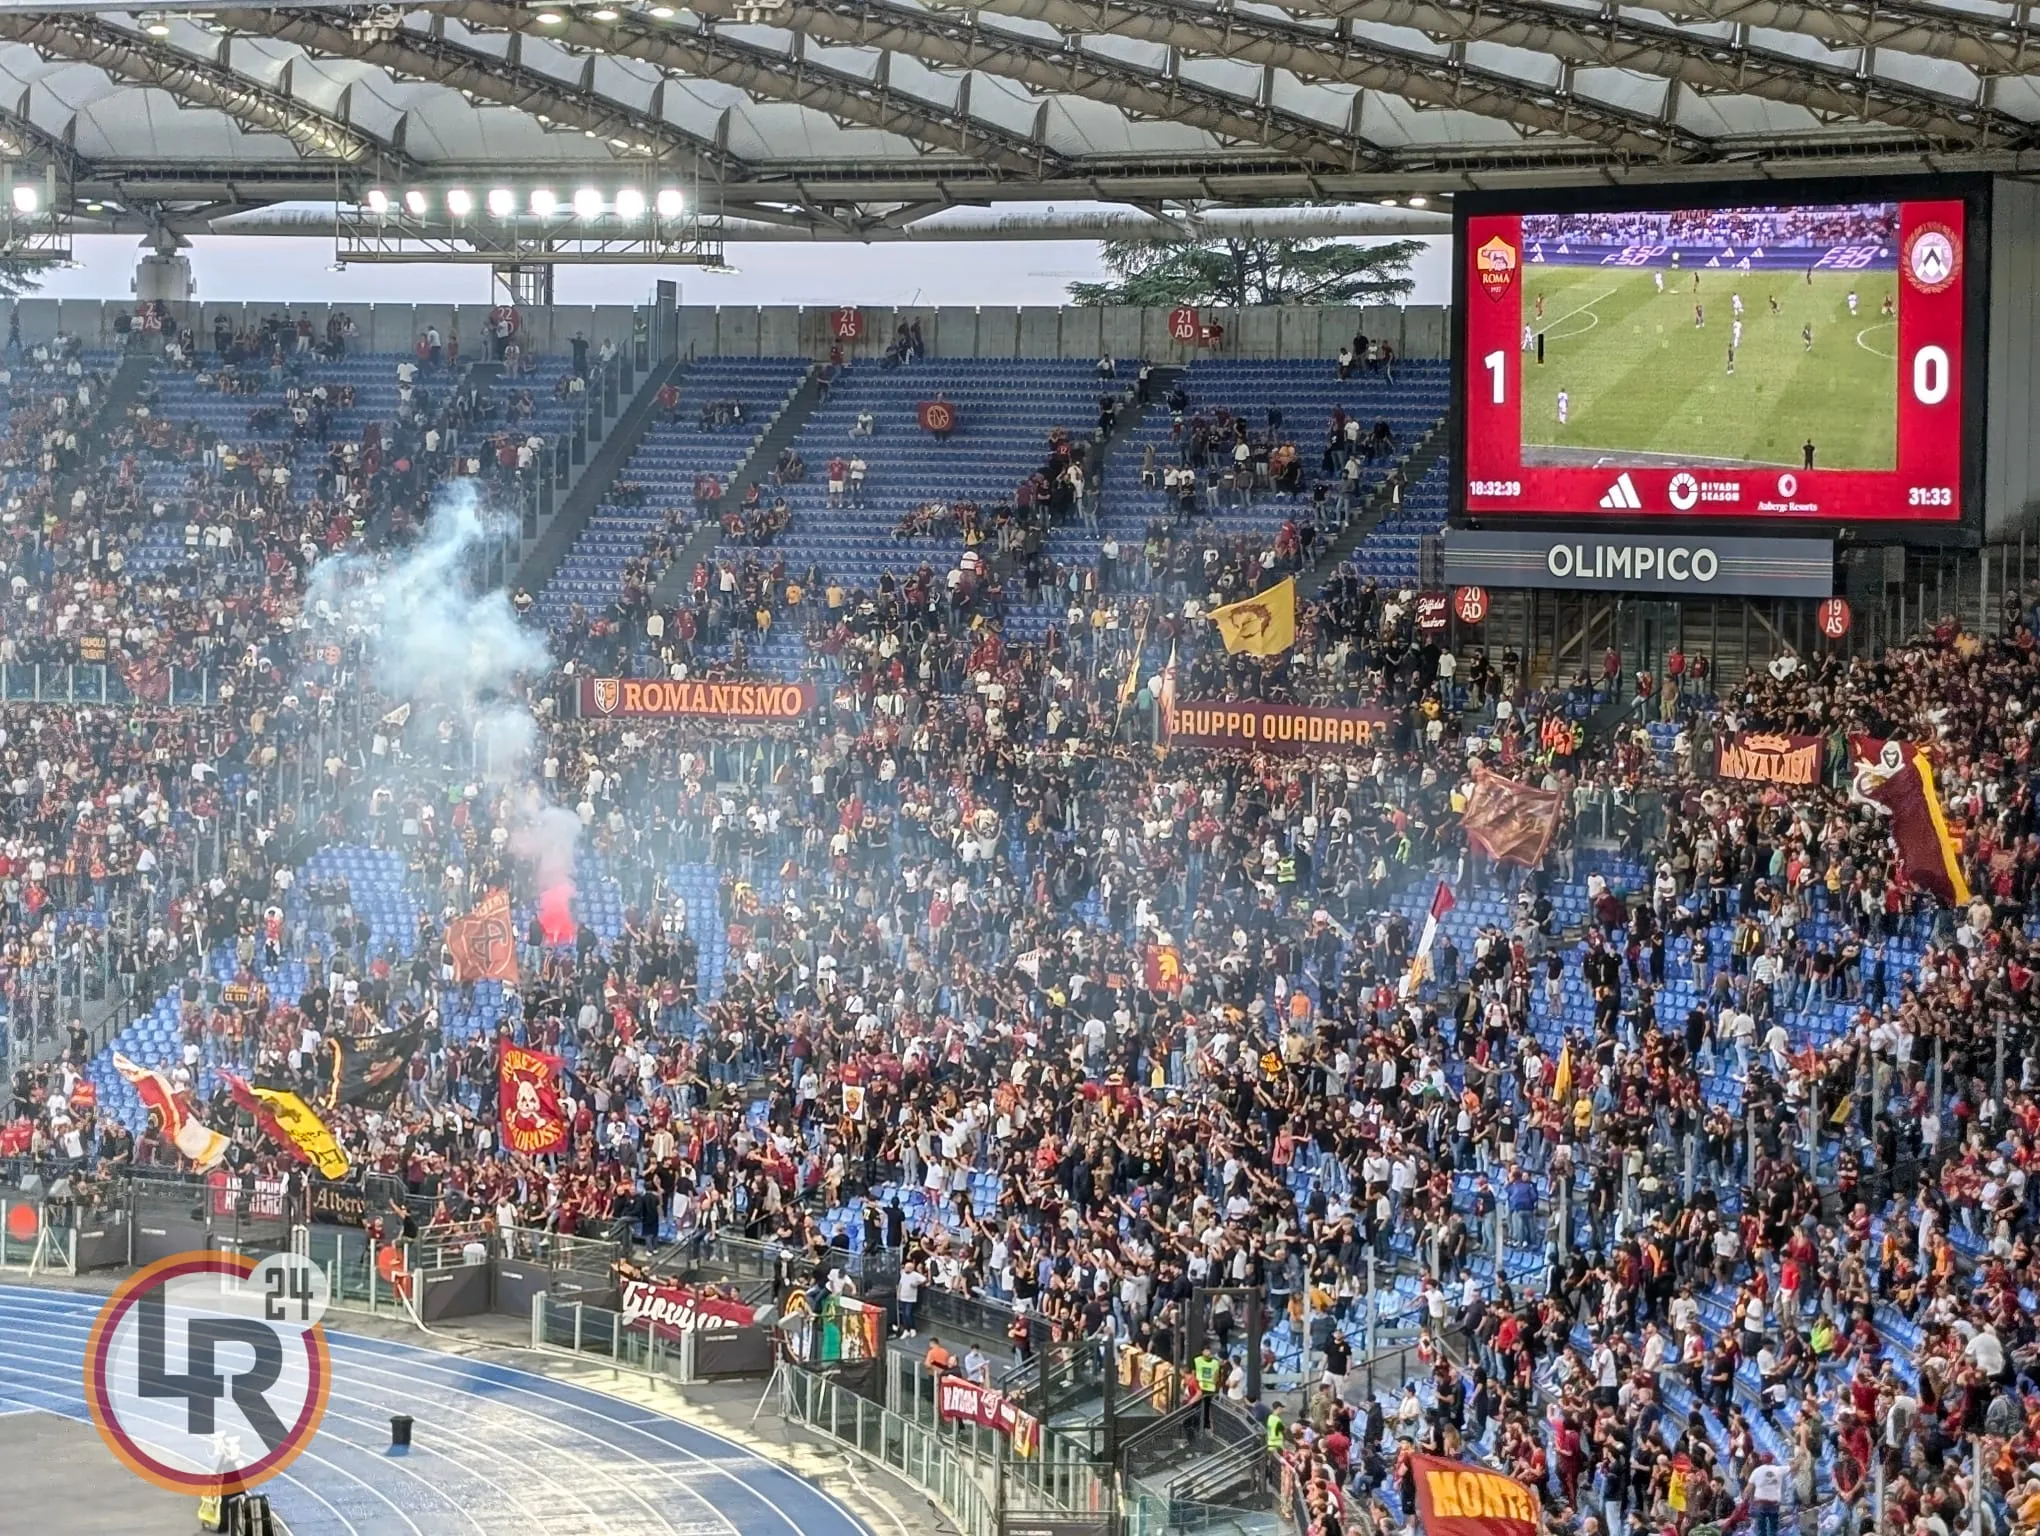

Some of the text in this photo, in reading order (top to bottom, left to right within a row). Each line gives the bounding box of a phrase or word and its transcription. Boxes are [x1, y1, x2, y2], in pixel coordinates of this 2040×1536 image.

[1600, 254, 1650, 266] F50
[1813, 255, 1872, 269] F50
[1482, 273, 1510, 284] ROMA
[498, 307, 512, 320] 22
[840, 309, 855, 322] 21
[1177, 310, 1192, 323] 21
[839, 323, 856, 337] AS
[1175, 324, 1193, 338] AD
[1484, 350, 1505, 404] 1
[1914, 345, 1949, 404] 0
[1469, 480, 1521, 496] 18:32:39
[1701, 492, 1740, 501] SEASON
[1908, 487, 1952, 506] 31:33
[1547, 544, 1718, 582] OLIMPICO
[1463, 586, 1481, 602] 20
[1461, 603, 1482, 619] AD
[1827, 599, 1842, 616] 19
[1825, 616, 1843, 634] AS
[624, 683, 802, 715] ROMANISMO
[1169, 709, 1256, 738] GRUPPO
